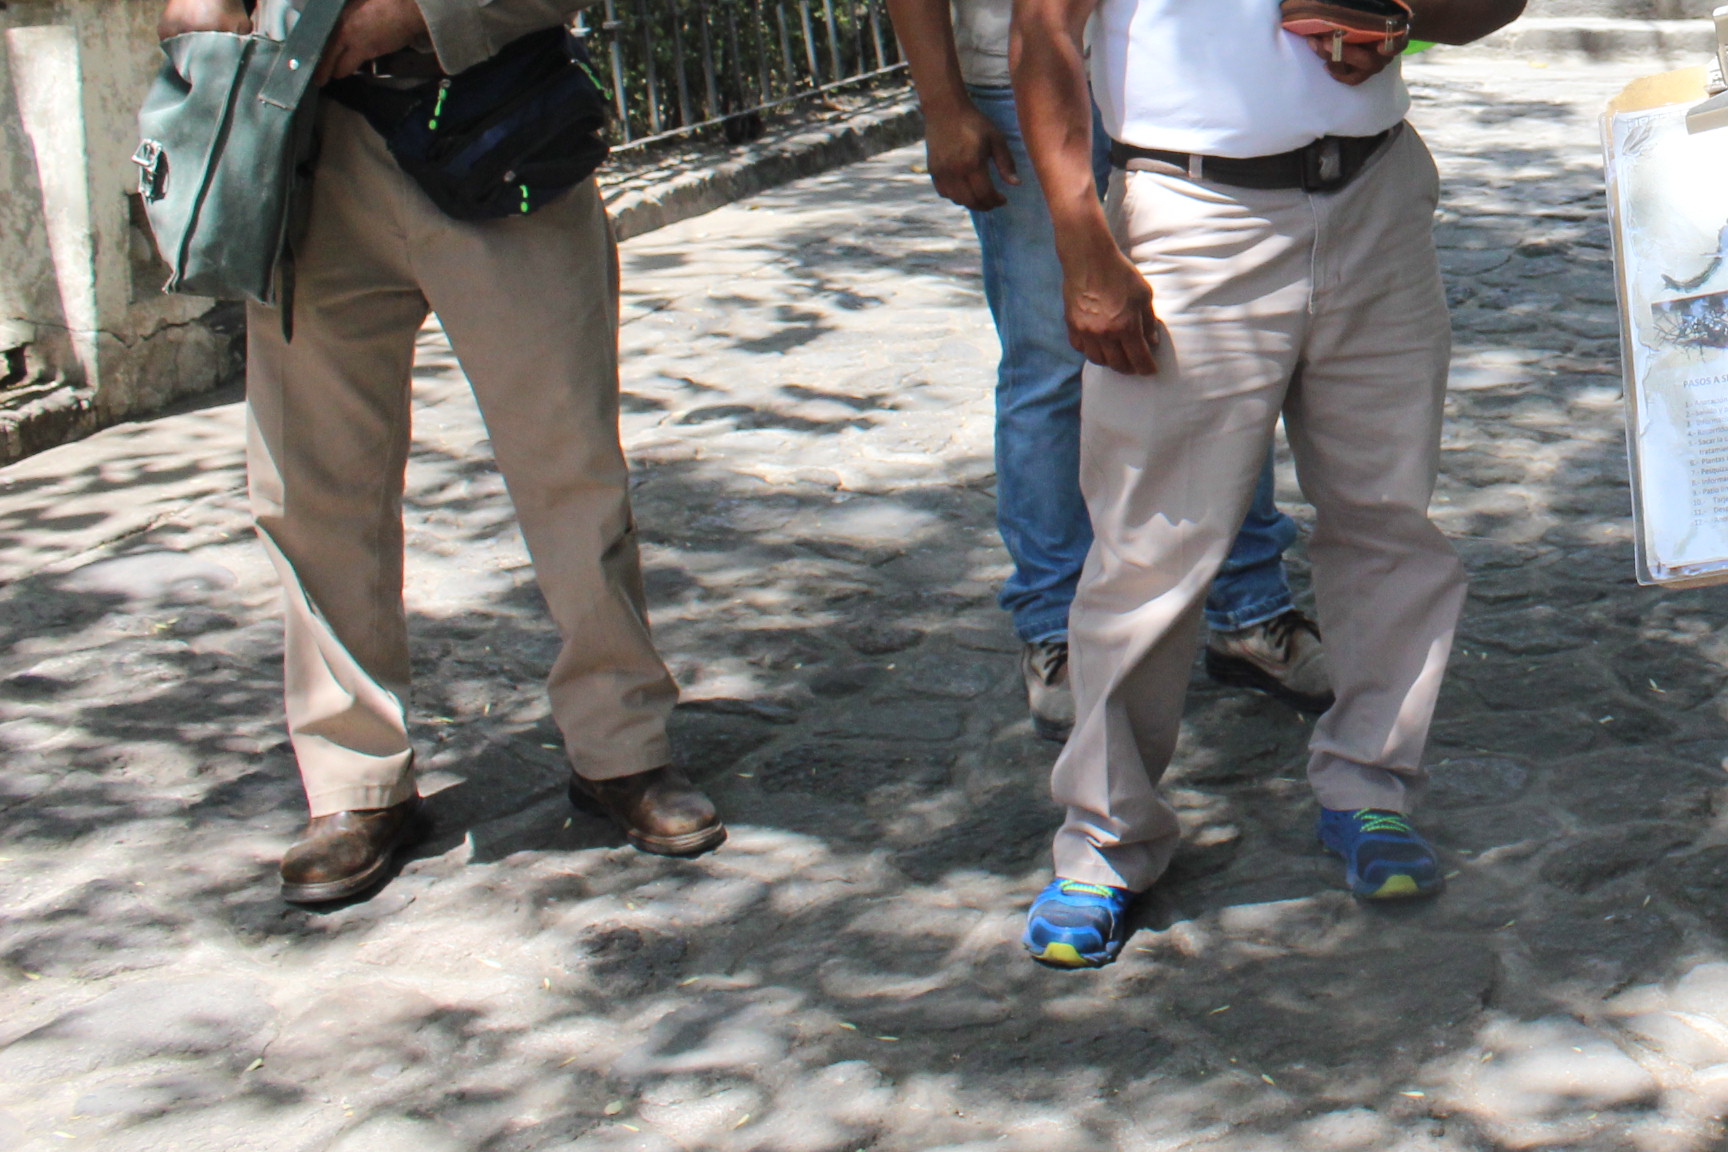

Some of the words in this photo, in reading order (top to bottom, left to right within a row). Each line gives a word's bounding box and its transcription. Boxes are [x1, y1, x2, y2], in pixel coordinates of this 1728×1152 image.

[1683, 377, 1711, 388] PASOS
[1713, 376, 1720, 384] A
[1701, 456, 1725, 465] Plantas
[1703, 487, 1720, 496] Patio
